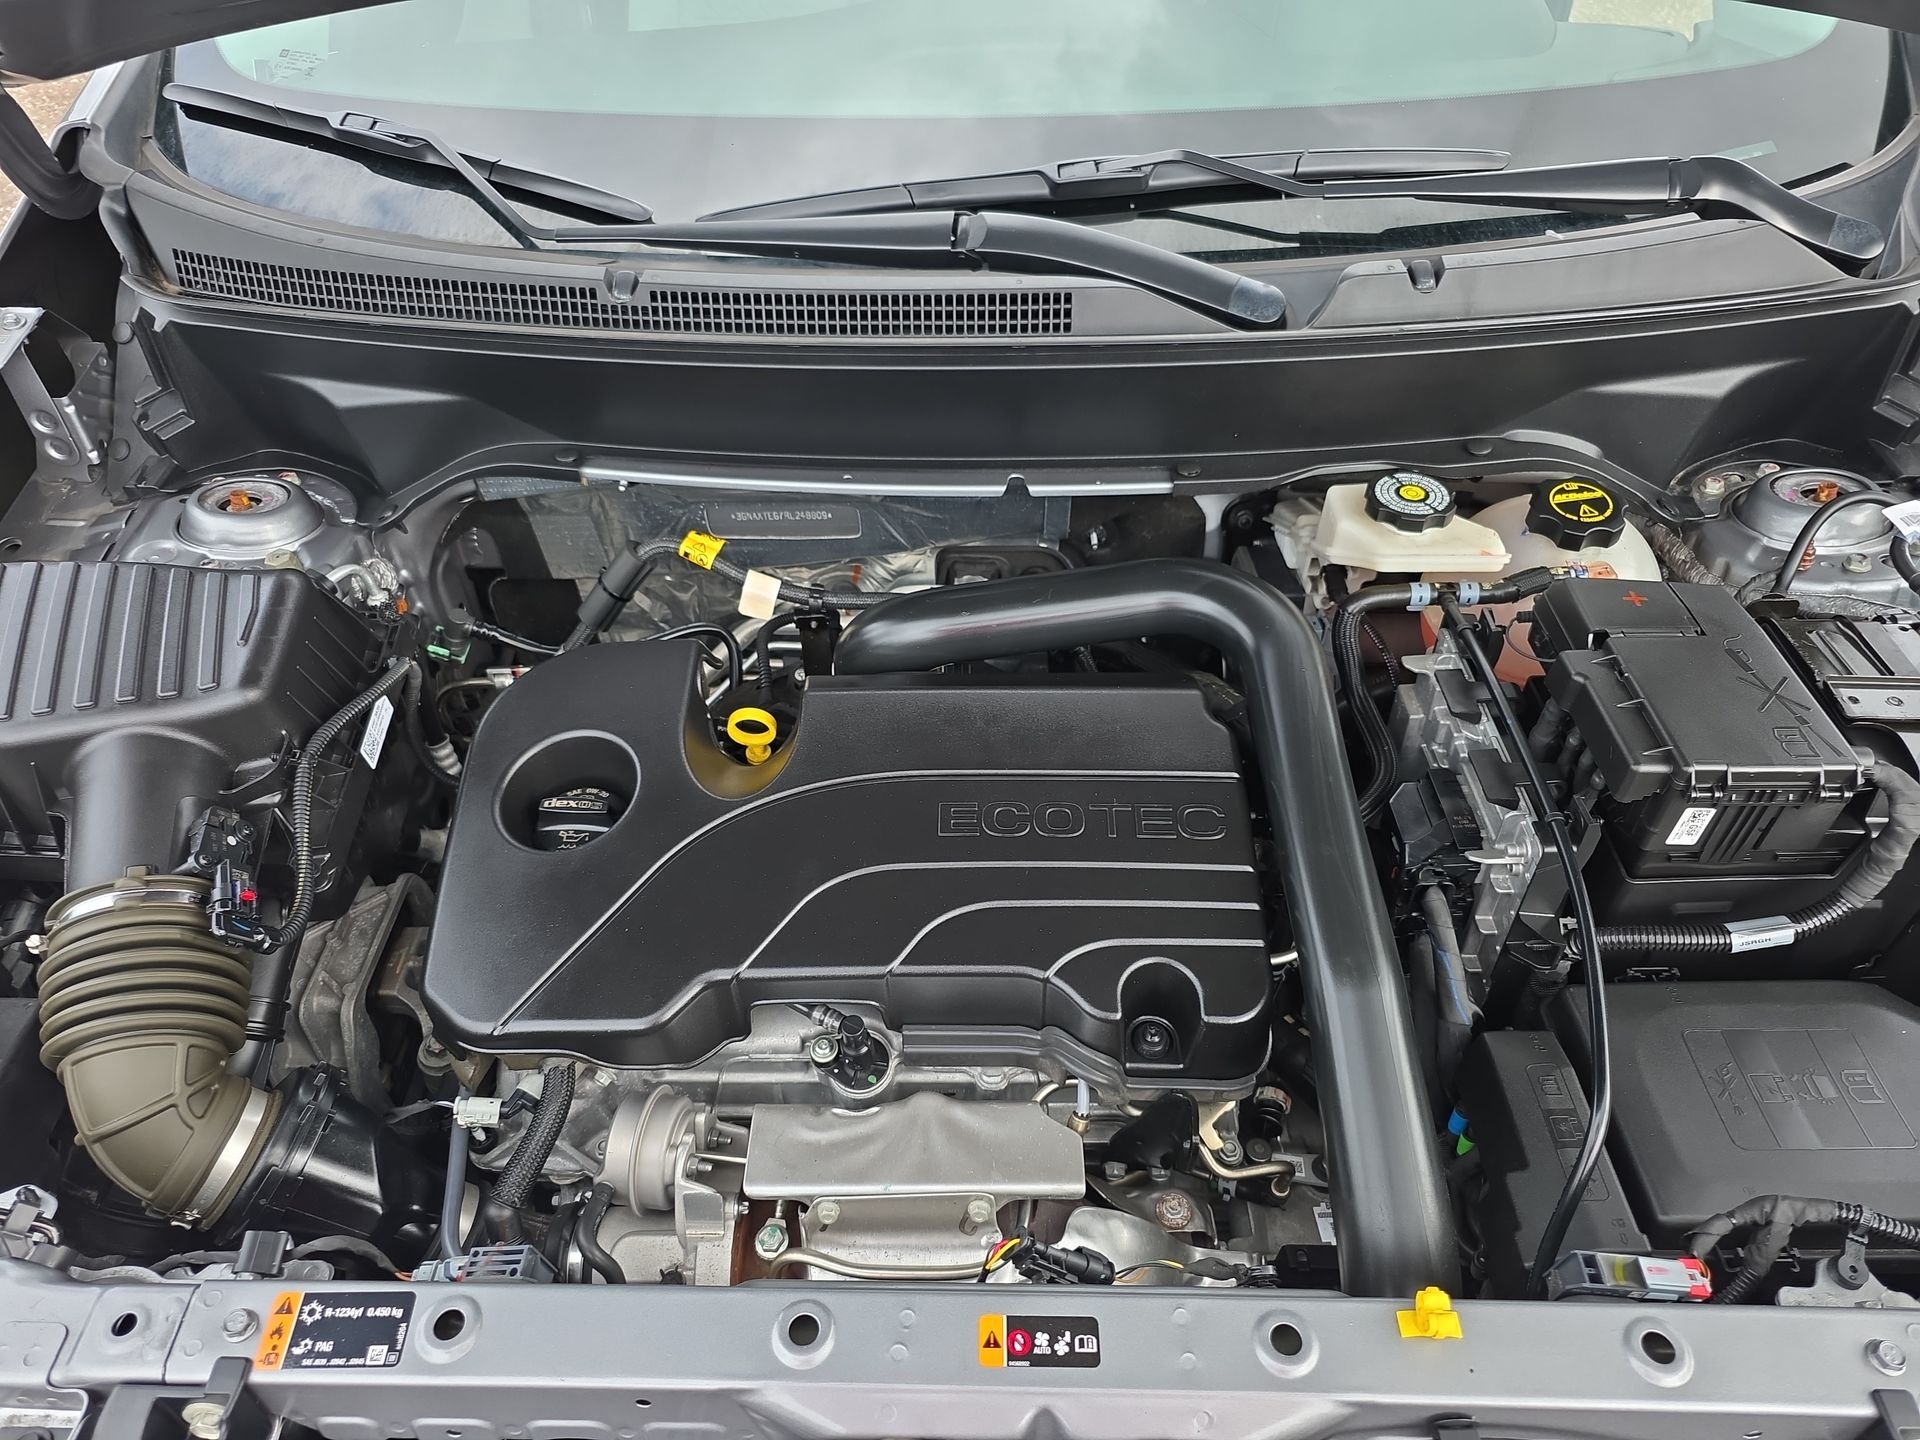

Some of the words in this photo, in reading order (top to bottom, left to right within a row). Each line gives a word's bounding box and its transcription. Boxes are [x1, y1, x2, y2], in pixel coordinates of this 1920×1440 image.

[566, 788, 583, 797] SAE
[585, 788, 610, 798] 0W-20
[937, 801, 1227, 840] ECOTEC
[367, 1307, 391, 1317] 0.450
[391, 1307, 404, 1319] kg
[314, 1341, 334, 1352] PAG
[1033, 1346, 1051, 1354] AUTO
